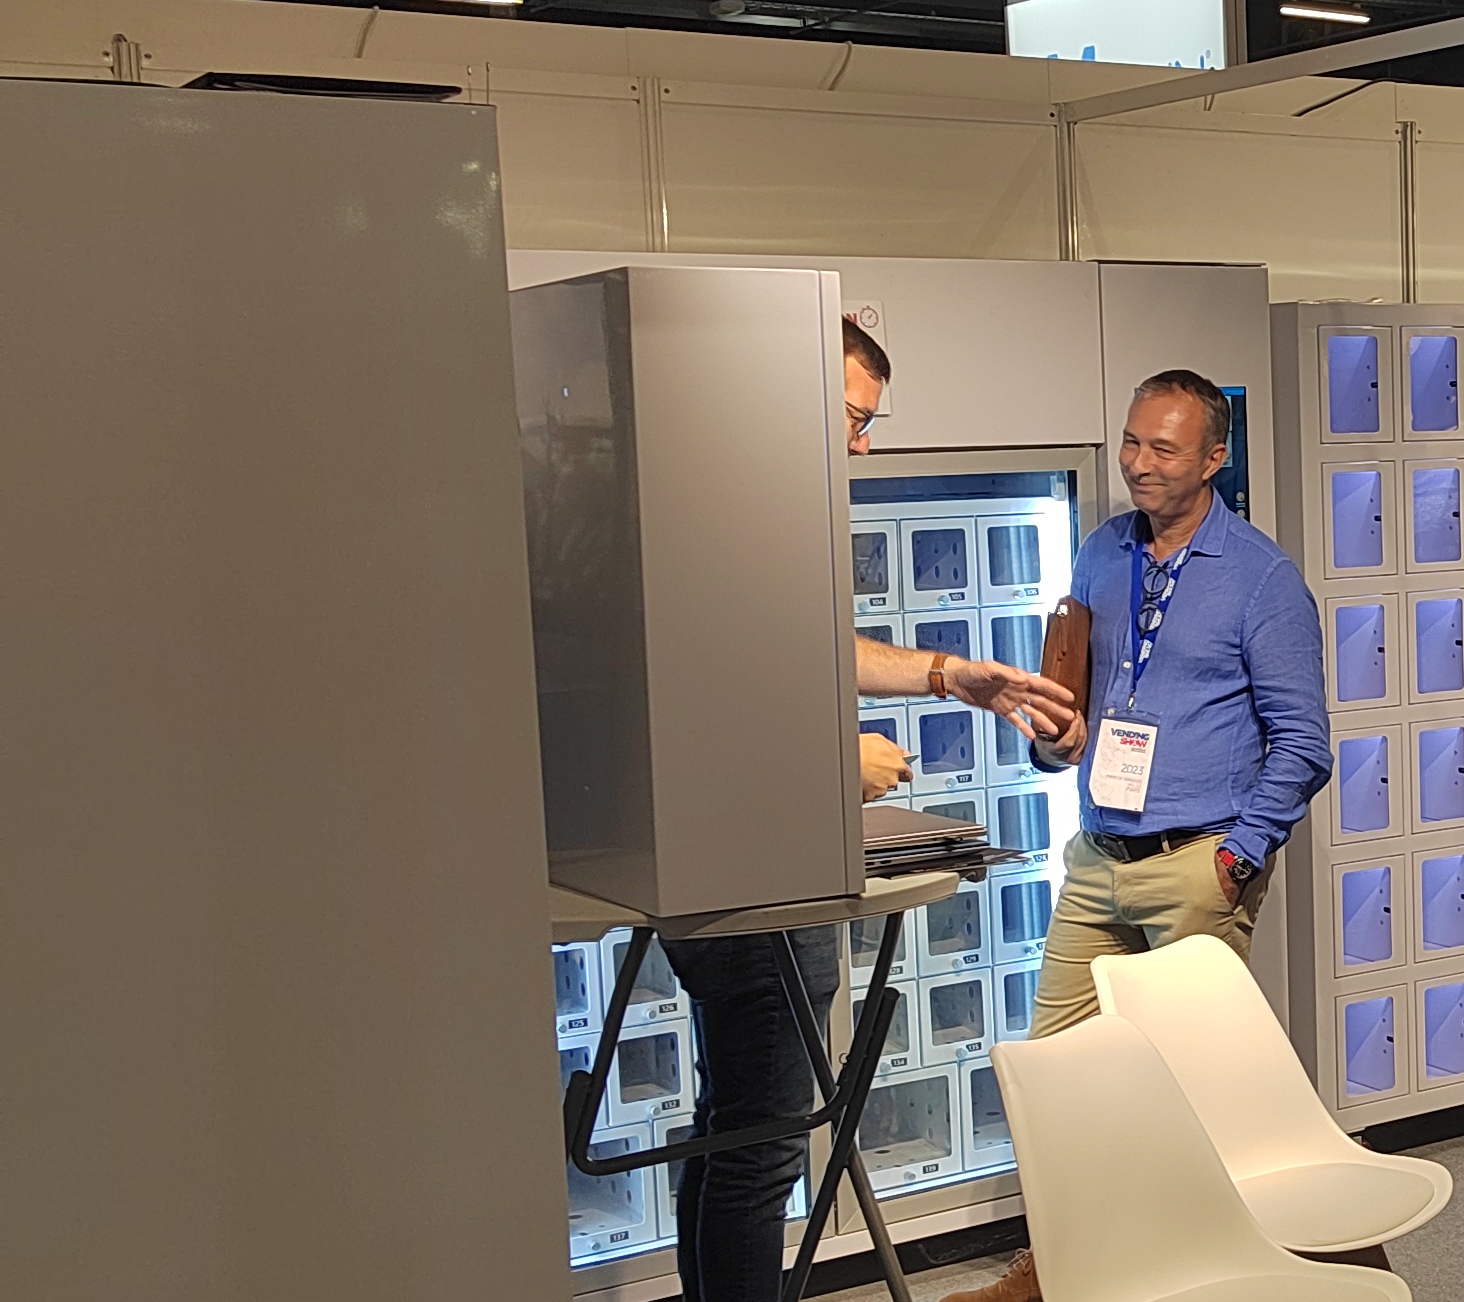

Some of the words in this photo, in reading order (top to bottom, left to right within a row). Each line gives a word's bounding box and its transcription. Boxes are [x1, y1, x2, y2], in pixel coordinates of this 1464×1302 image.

[1110, 727, 1150, 741] VENDING
[1119, 737, 1148, 748] SHOW
[1120, 763, 1145, 776] 2023
[661, 1004, 674, 1012] 126
[571, 1020, 584, 1028] 125
[664, 1101, 677, 1109] 132
[612, 1233, 625, 1241] 137
